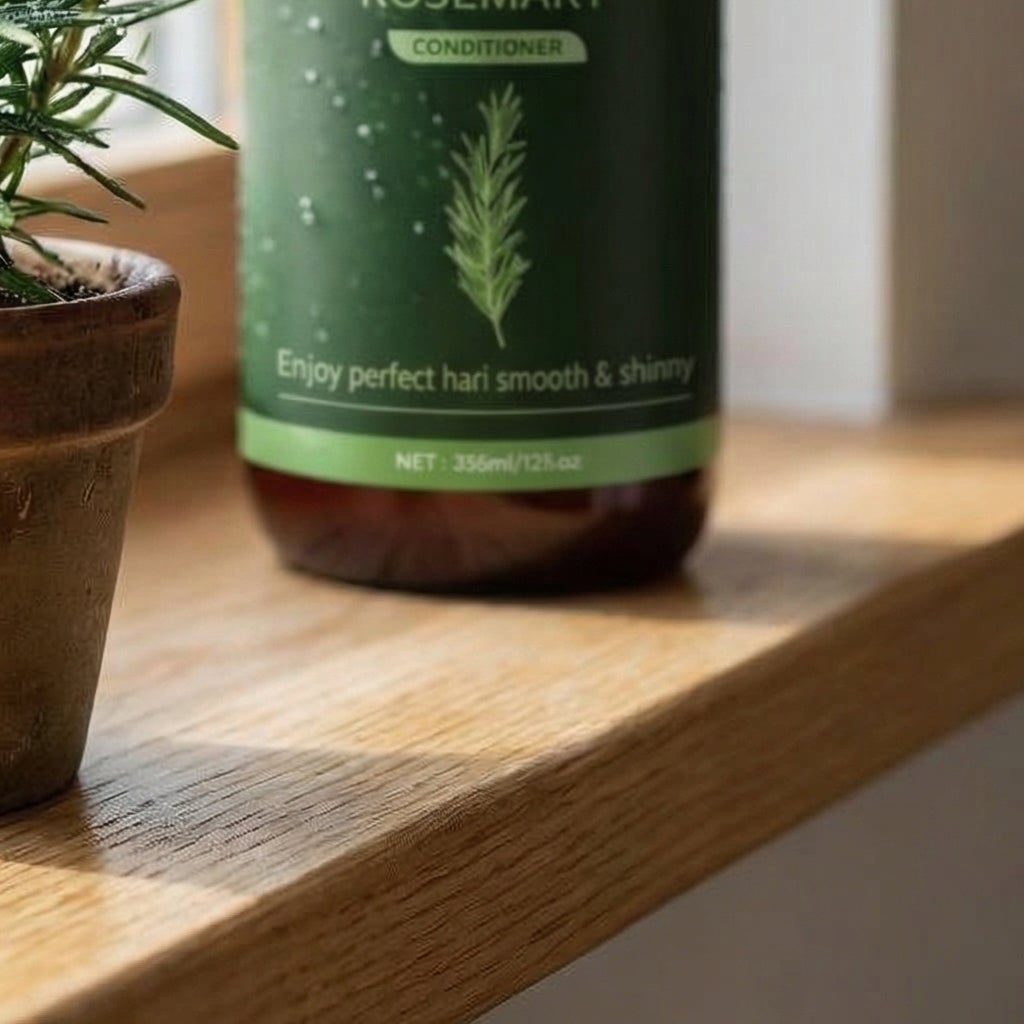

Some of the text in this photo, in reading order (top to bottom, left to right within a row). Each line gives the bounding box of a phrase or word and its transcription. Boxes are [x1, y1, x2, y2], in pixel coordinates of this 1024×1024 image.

[413, 38, 563, 57] CONDITIONER
[277, 348, 696, 393] Enjoy perfect hari smooth & shinny
[396, 453, 436, 471] NET
